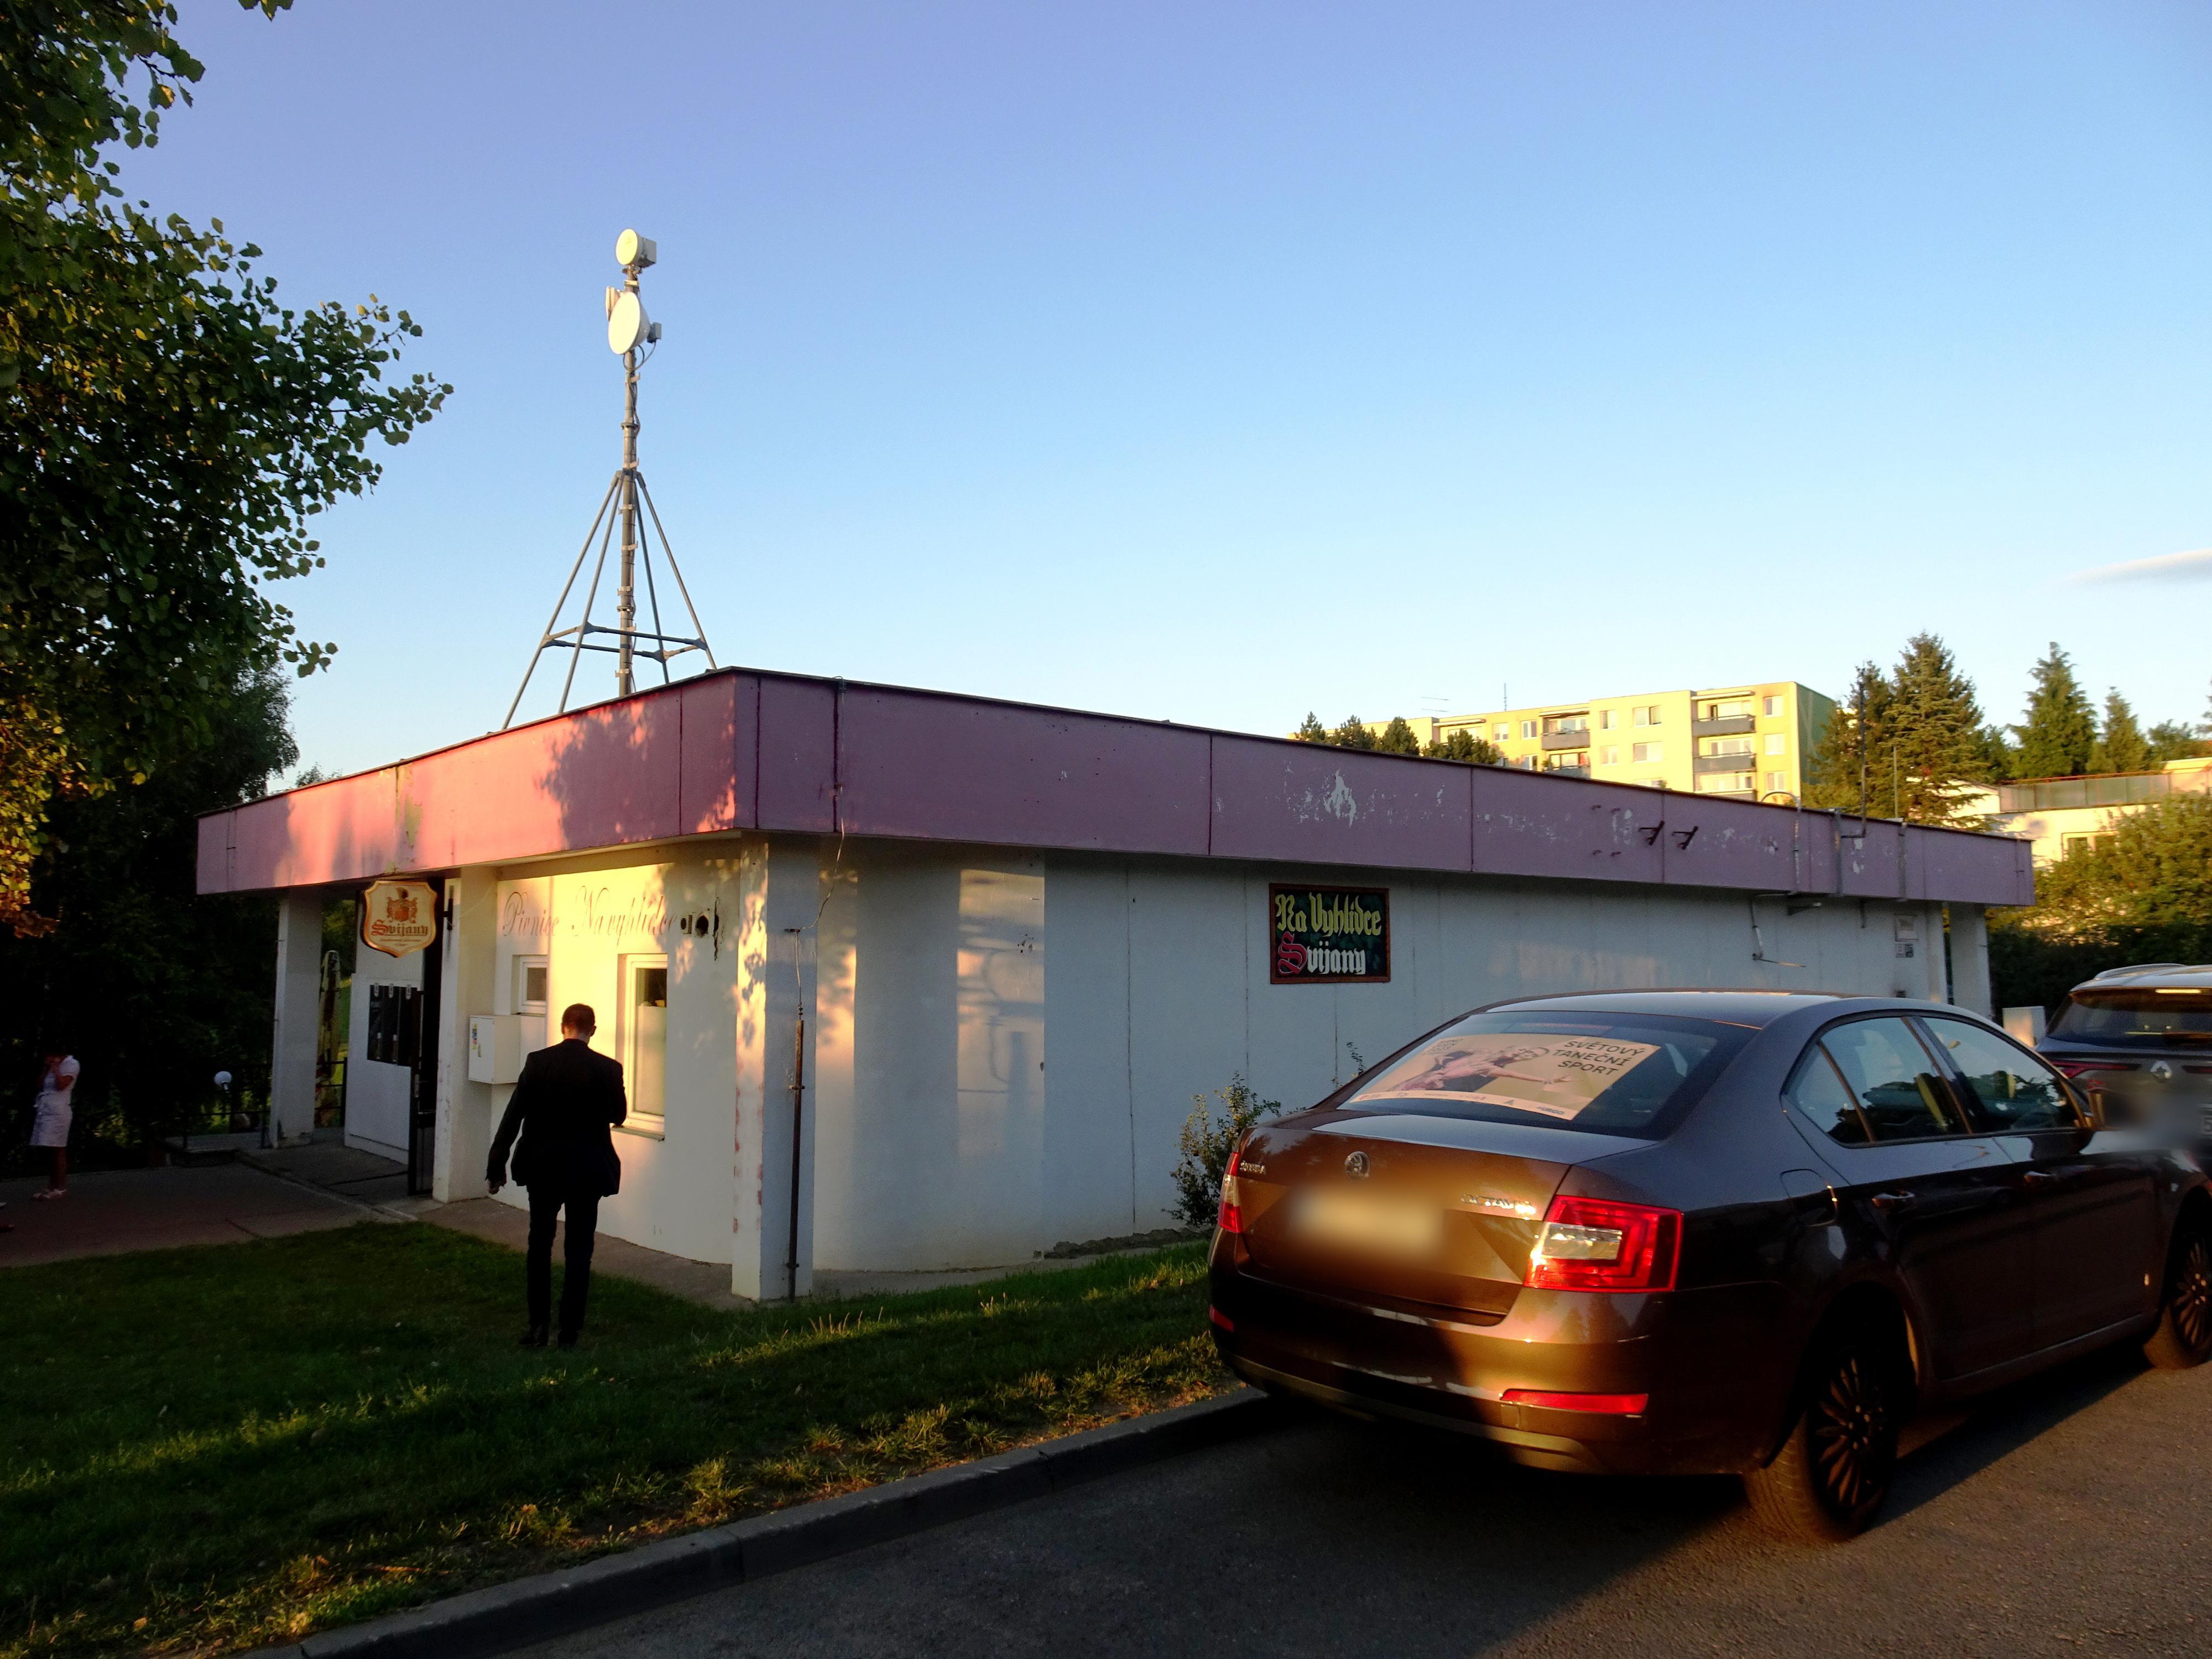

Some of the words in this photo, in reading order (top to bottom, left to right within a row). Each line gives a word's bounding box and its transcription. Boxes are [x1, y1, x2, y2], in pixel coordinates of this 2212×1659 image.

[1275, 893, 1307, 932] Na
[371, 919, 428, 937] Svijany
[1277, 931, 1366, 975] Svijany
[1564, 1041, 1646, 1056] SVĚTOVÝ
[1552, 1049, 1631, 1066] TANEČNÍ
[1558, 1061, 1619, 1076] SPORT
